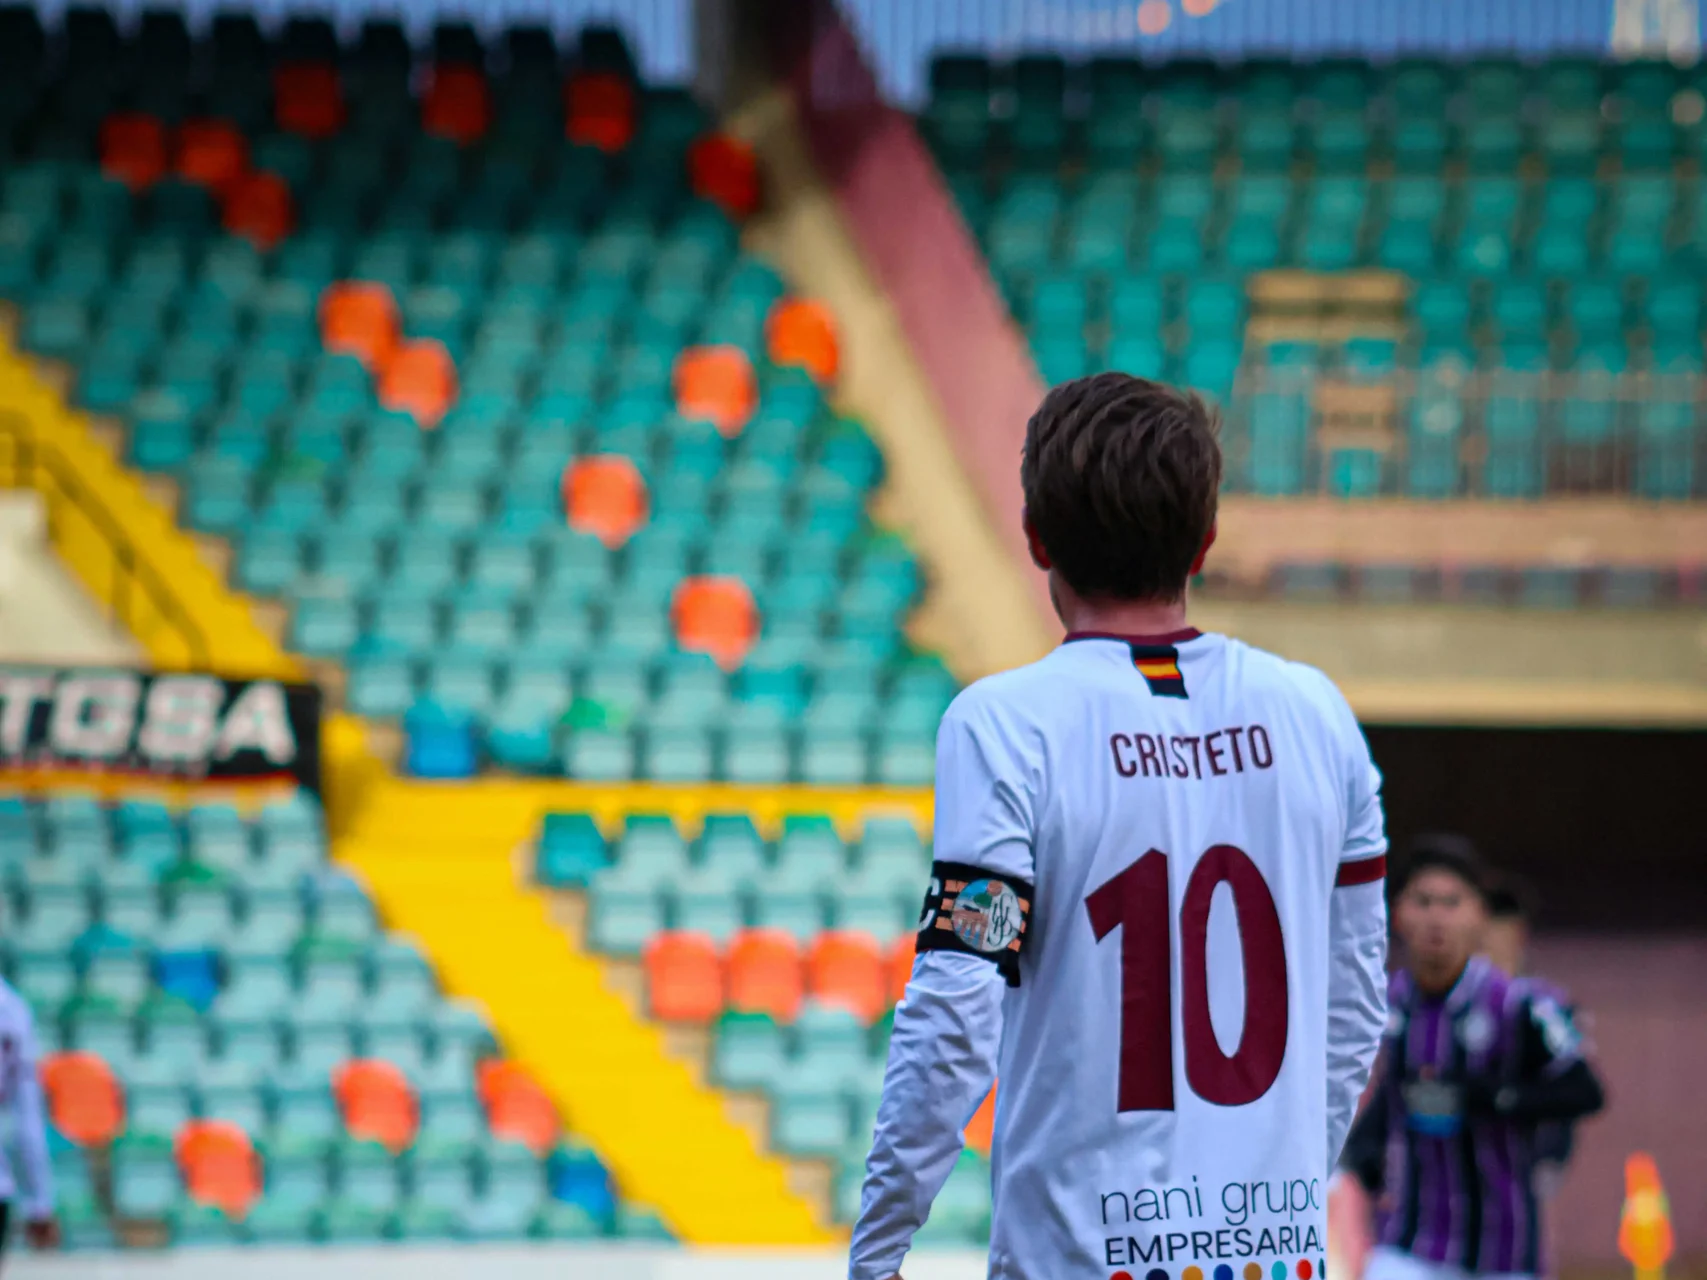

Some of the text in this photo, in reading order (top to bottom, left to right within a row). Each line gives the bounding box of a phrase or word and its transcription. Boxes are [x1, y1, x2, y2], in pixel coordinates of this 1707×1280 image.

[1110, 725, 1273, 780] CRISTETO
[1084, 843, 1289, 1114] 10
[1100, 1174, 1204, 1226] nani
